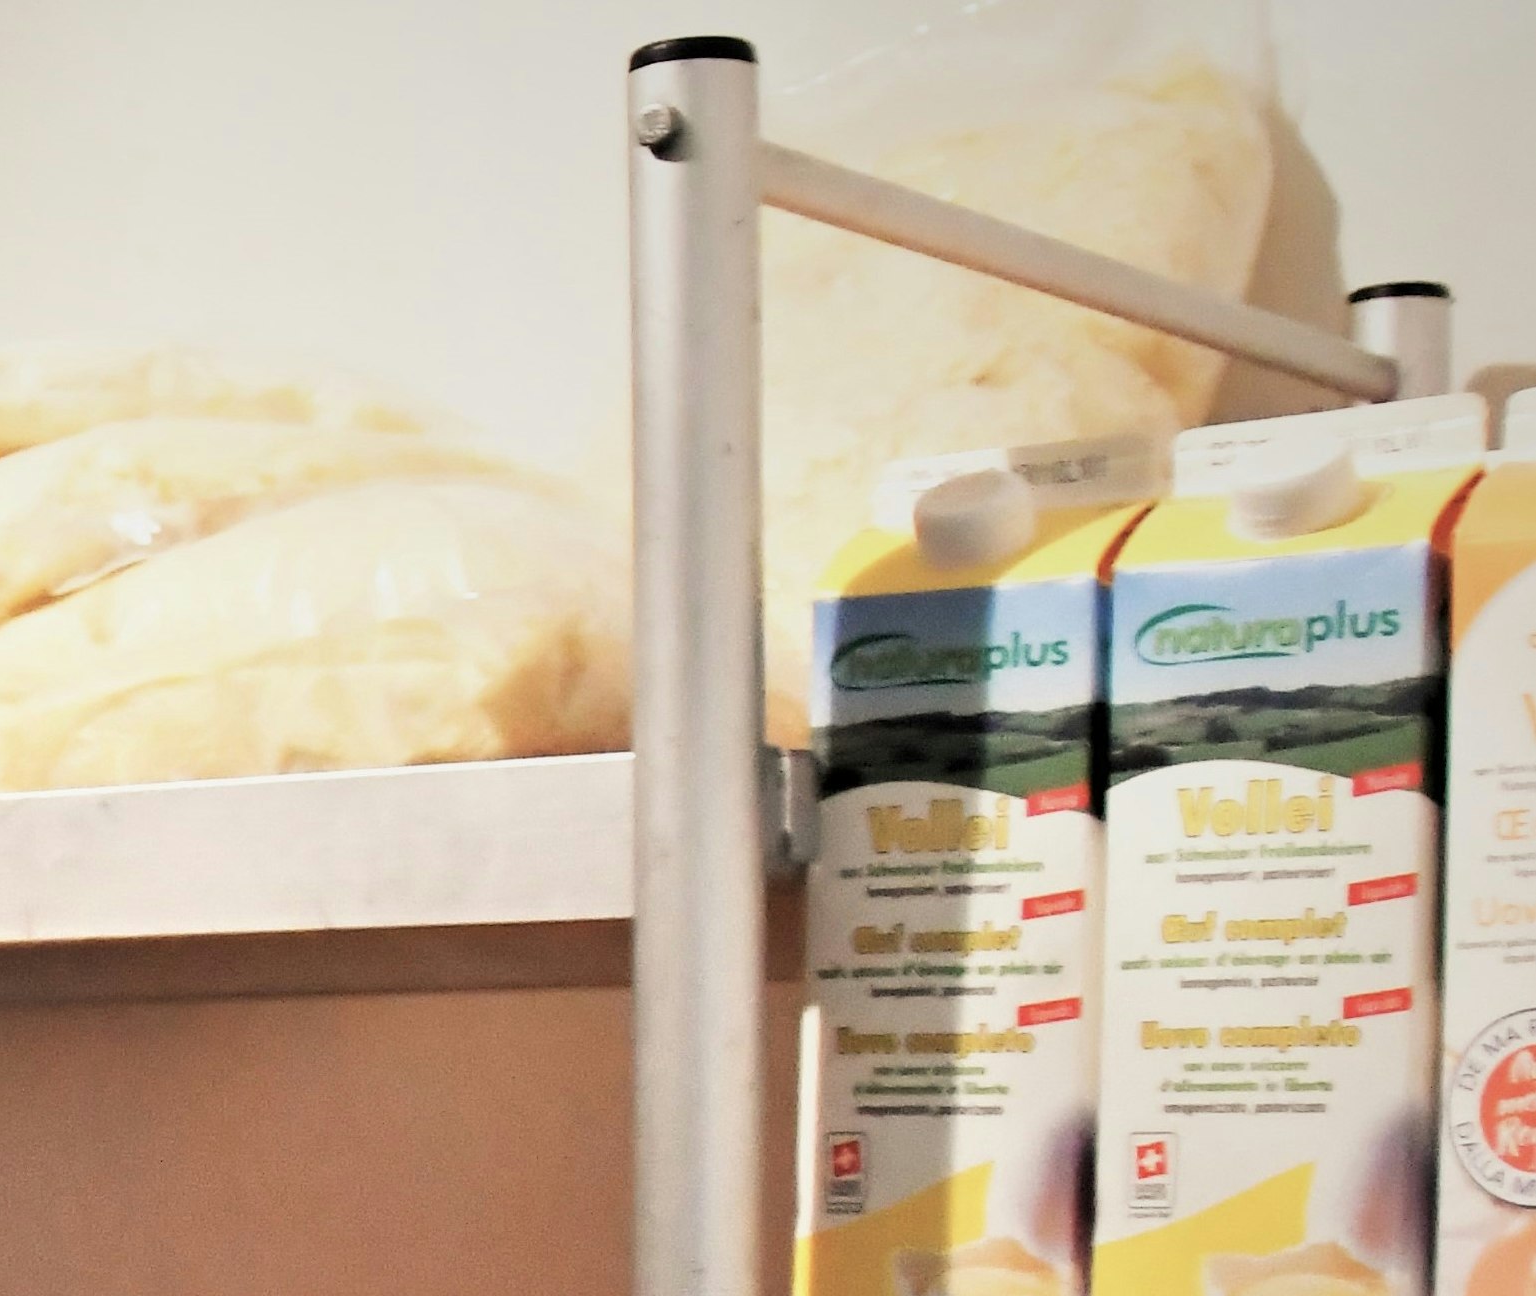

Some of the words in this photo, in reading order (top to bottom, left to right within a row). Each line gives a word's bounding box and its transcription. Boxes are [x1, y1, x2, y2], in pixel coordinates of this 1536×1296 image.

[1153, 600, 1401, 656] naturaplus
[867, 795, 1010, 854] Vollei
[1177, 774, 1335, 838] Vollei
